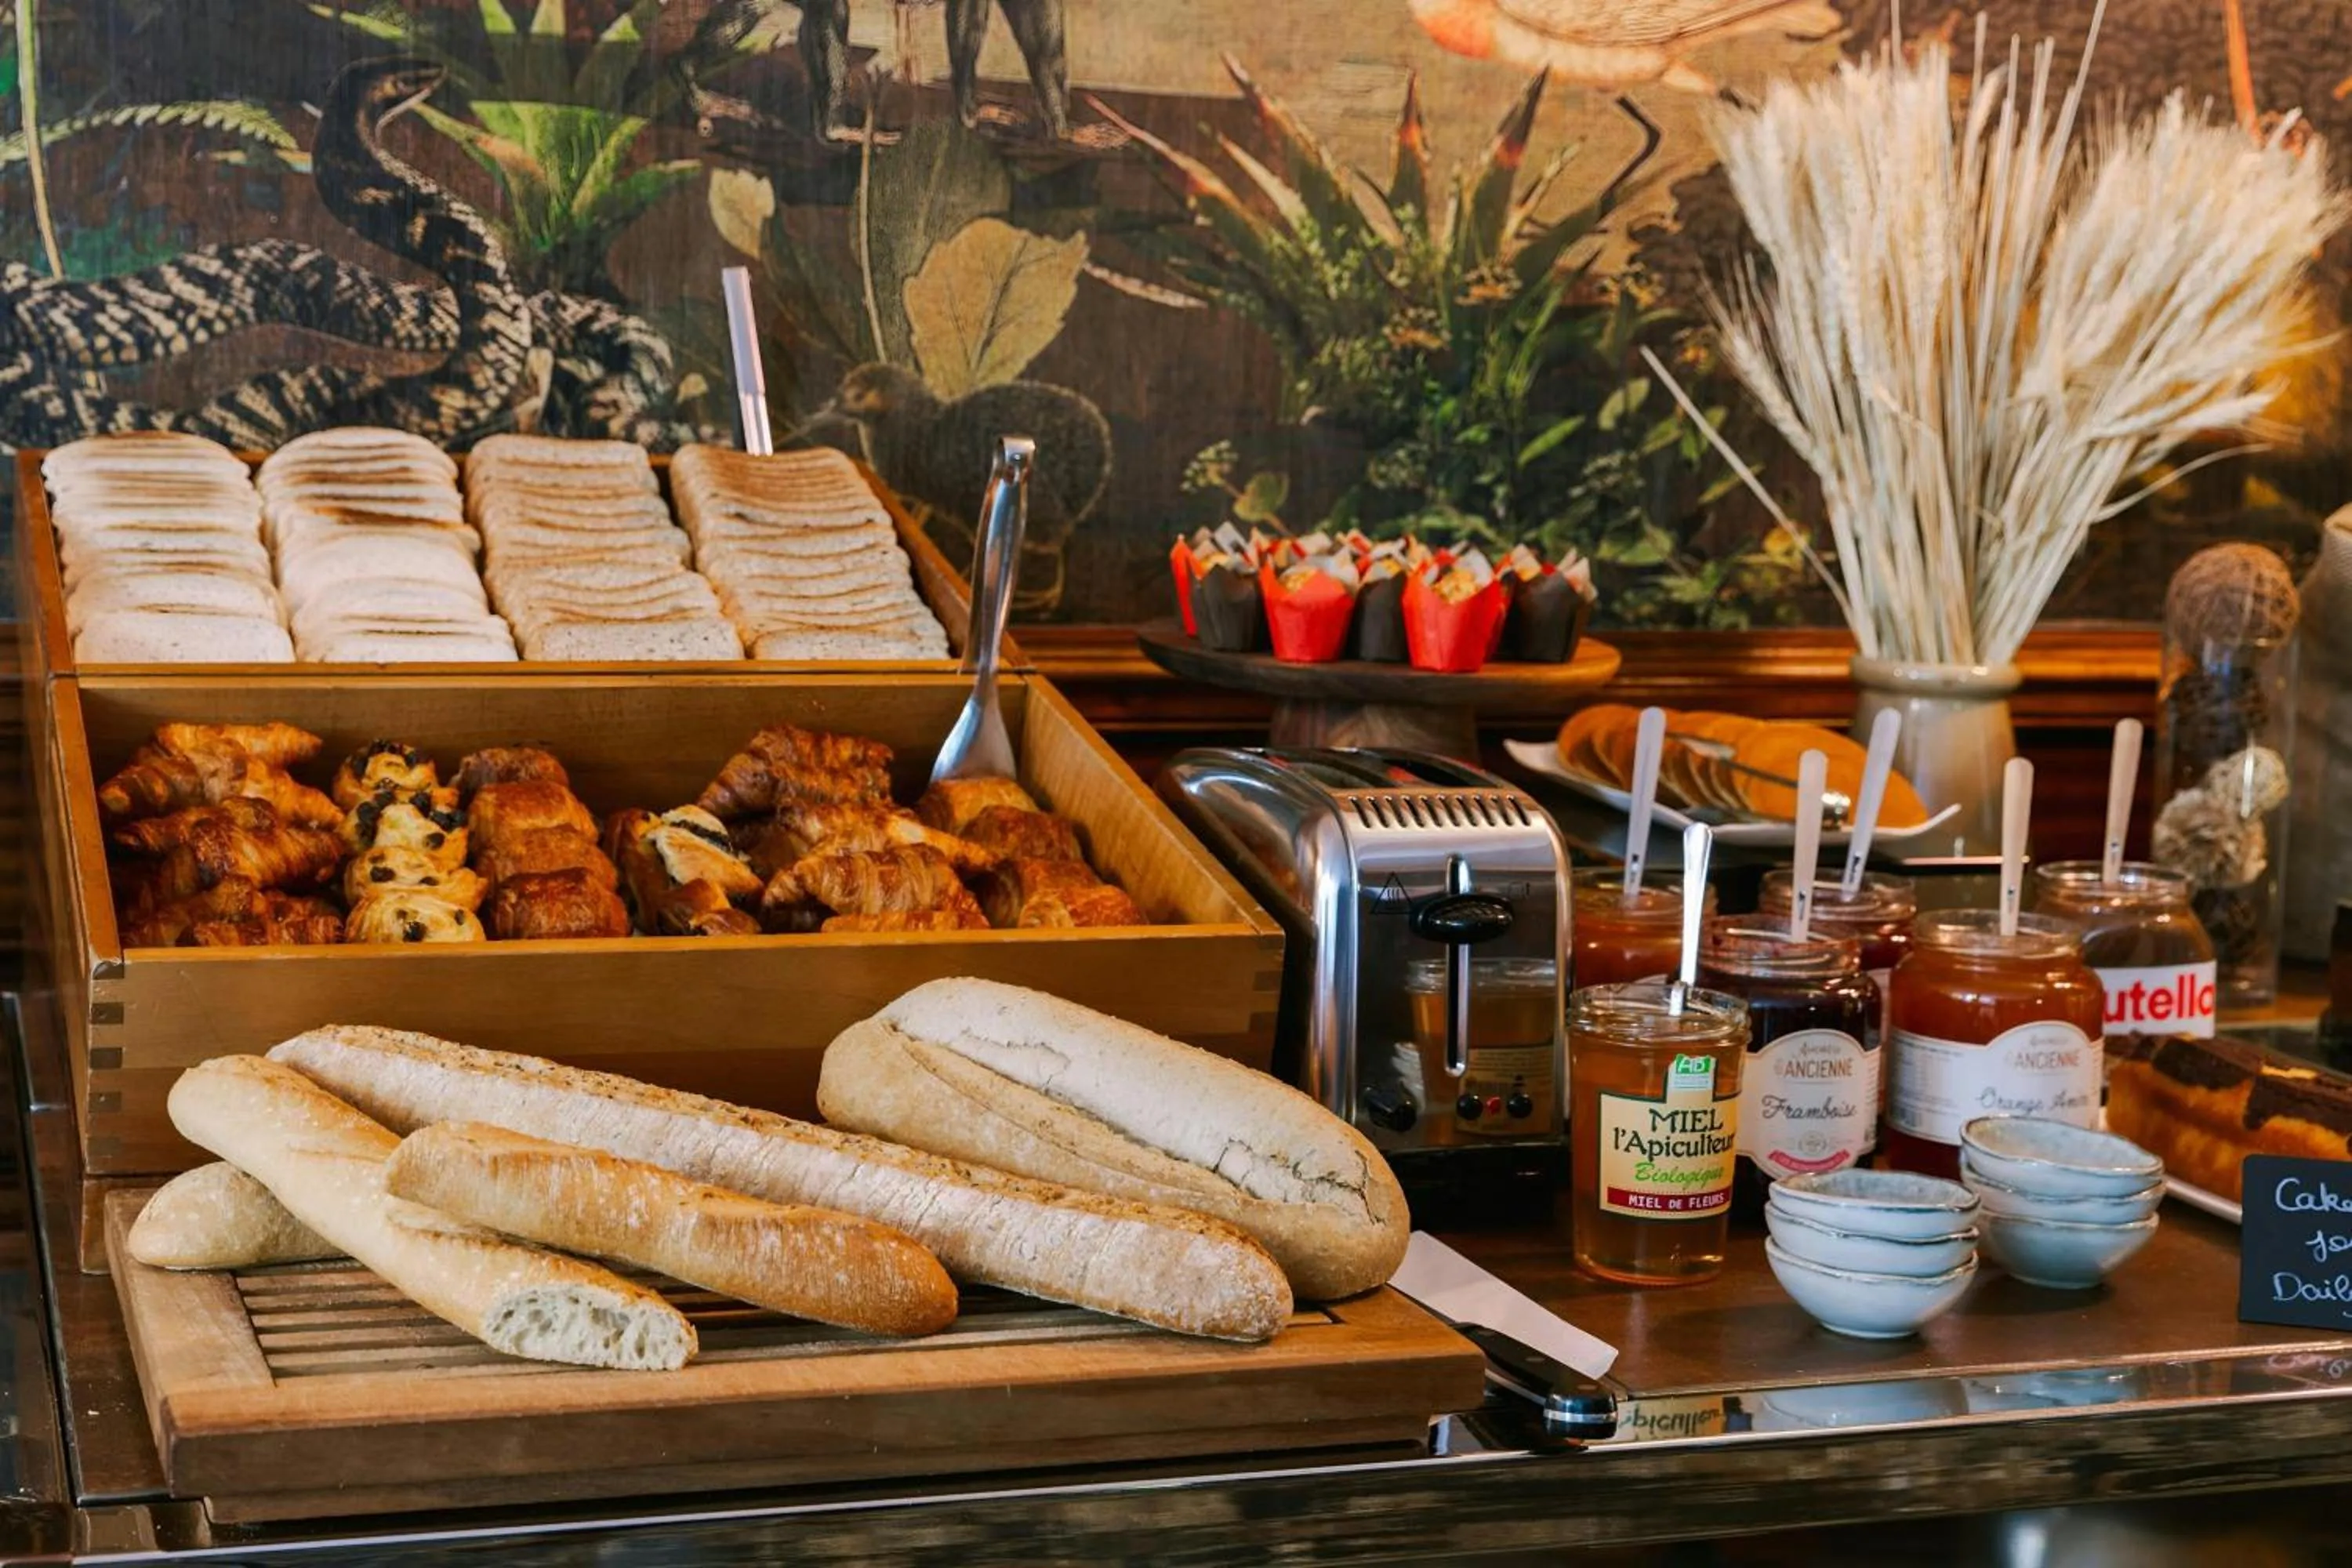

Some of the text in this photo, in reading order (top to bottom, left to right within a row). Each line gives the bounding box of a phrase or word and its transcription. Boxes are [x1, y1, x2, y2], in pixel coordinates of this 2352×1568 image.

[2103, 974, 2215, 1022] utella
[1784, 1058, 1853, 1079] ANCIENNE
[1649, 1108, 1724, 1134] MIEL
[1613, 1127, 1735, 1163] l'Apiculteur
[1628, 1192, 1725, 1210] MIEL DE FLEURS
[2273, 1271, 2352, 1317] Dail
